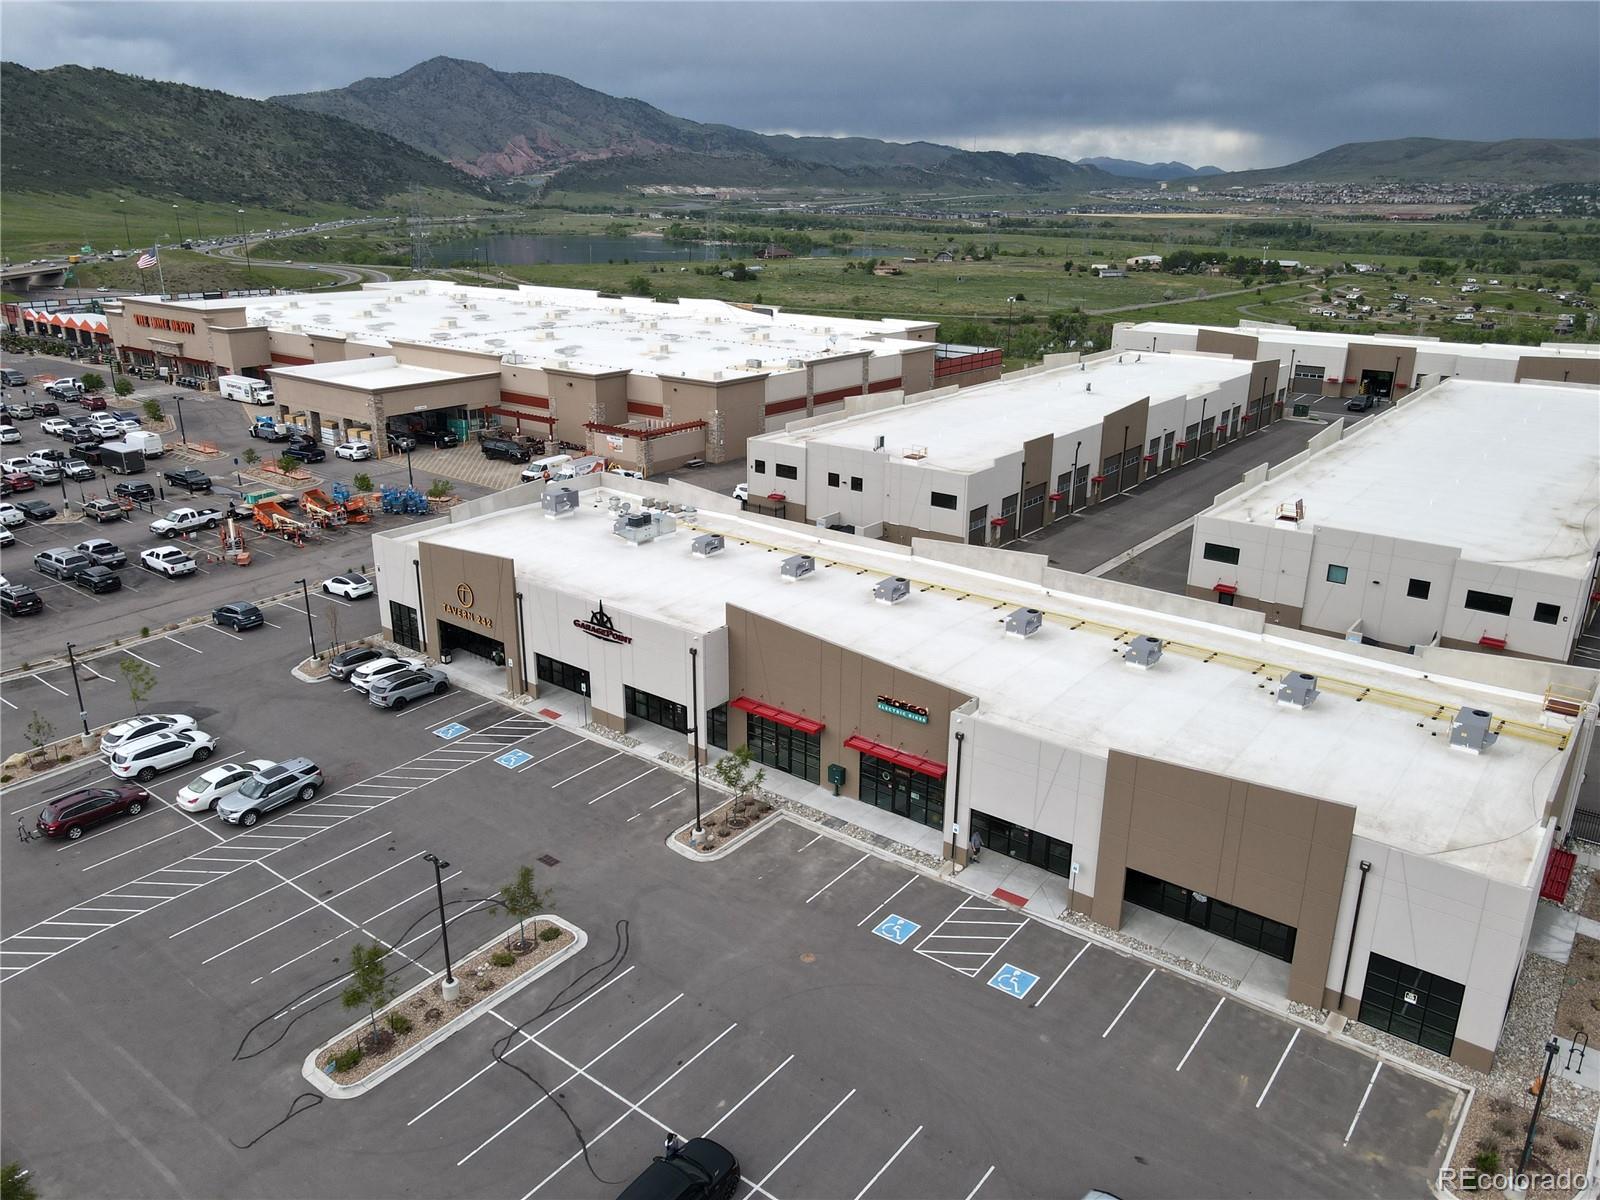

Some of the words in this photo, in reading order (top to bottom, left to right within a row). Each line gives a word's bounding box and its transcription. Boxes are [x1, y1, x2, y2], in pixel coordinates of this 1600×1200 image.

[171, 320, 195, 335] DEPOT
[443, 604, 475, 621] TAVERN
[475, 615, 493, 628] 242
